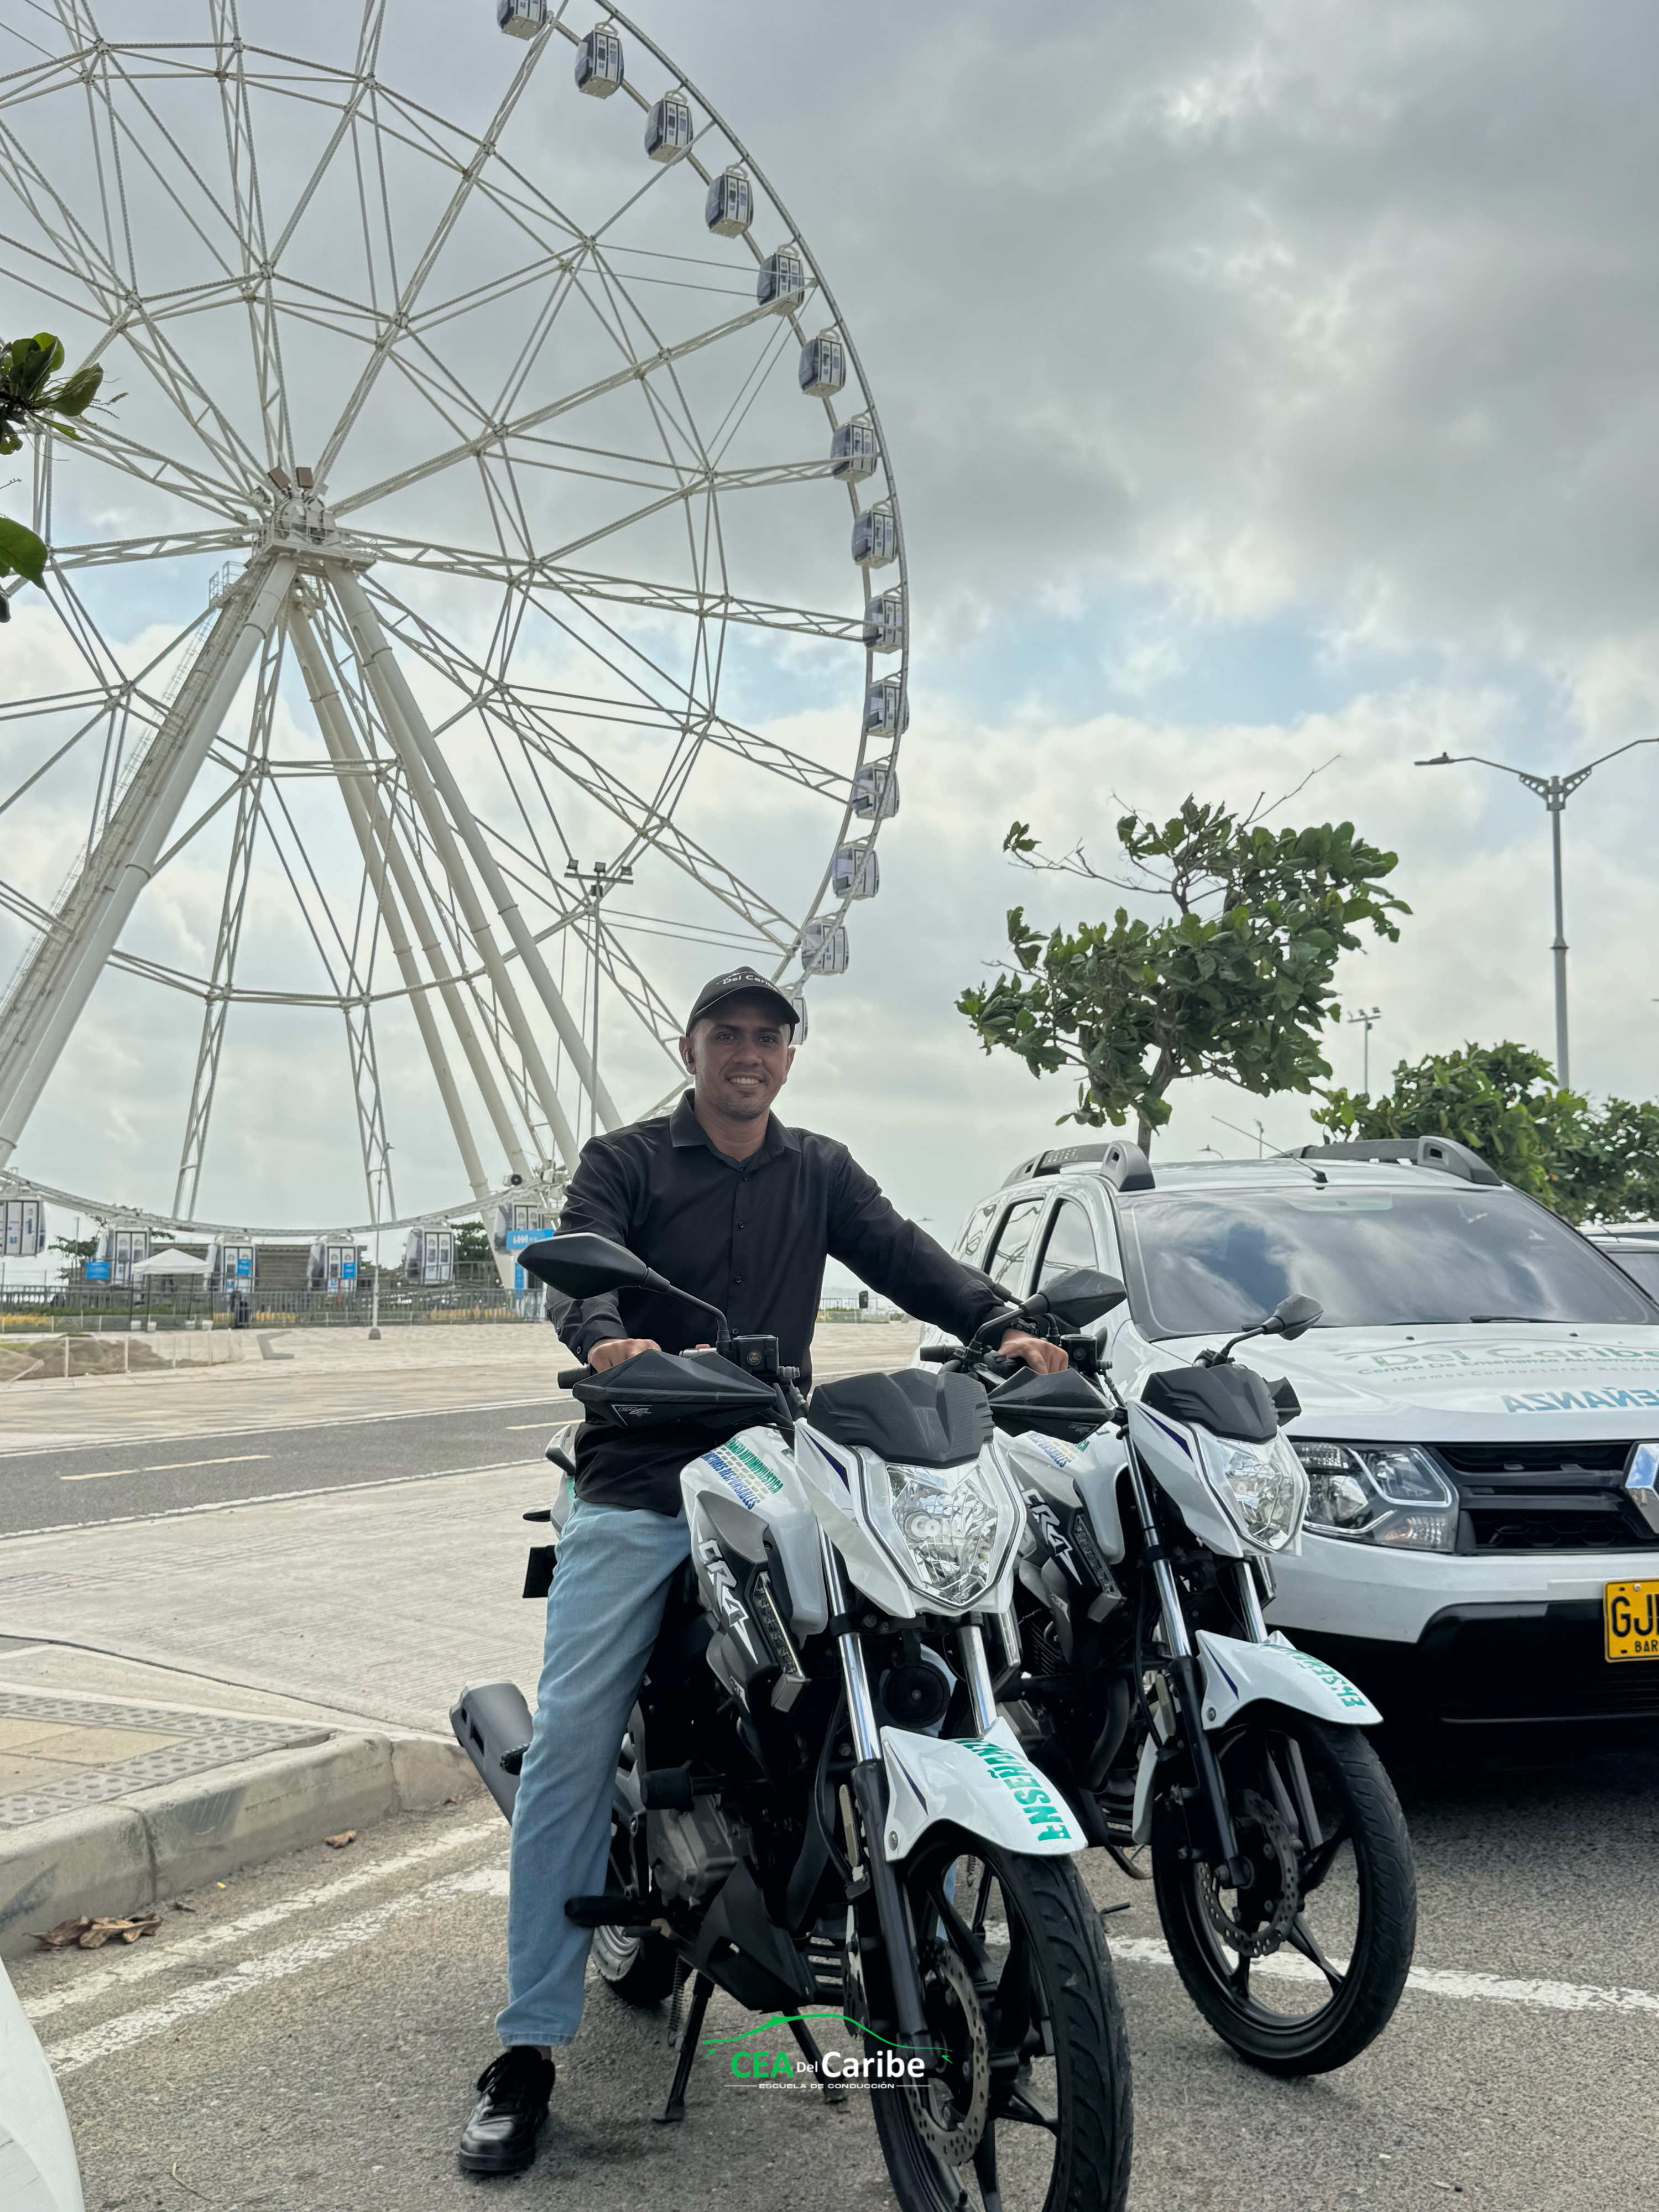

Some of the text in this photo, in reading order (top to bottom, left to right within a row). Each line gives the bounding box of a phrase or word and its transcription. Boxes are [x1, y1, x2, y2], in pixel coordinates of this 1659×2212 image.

[723, 975, 742, 984] Del
[1371, 1349, 1470, 1366] Del
[1358, 1364, 1424, 1375] Centro
[719, 1467, 761, 1510] RESPONSABLES
